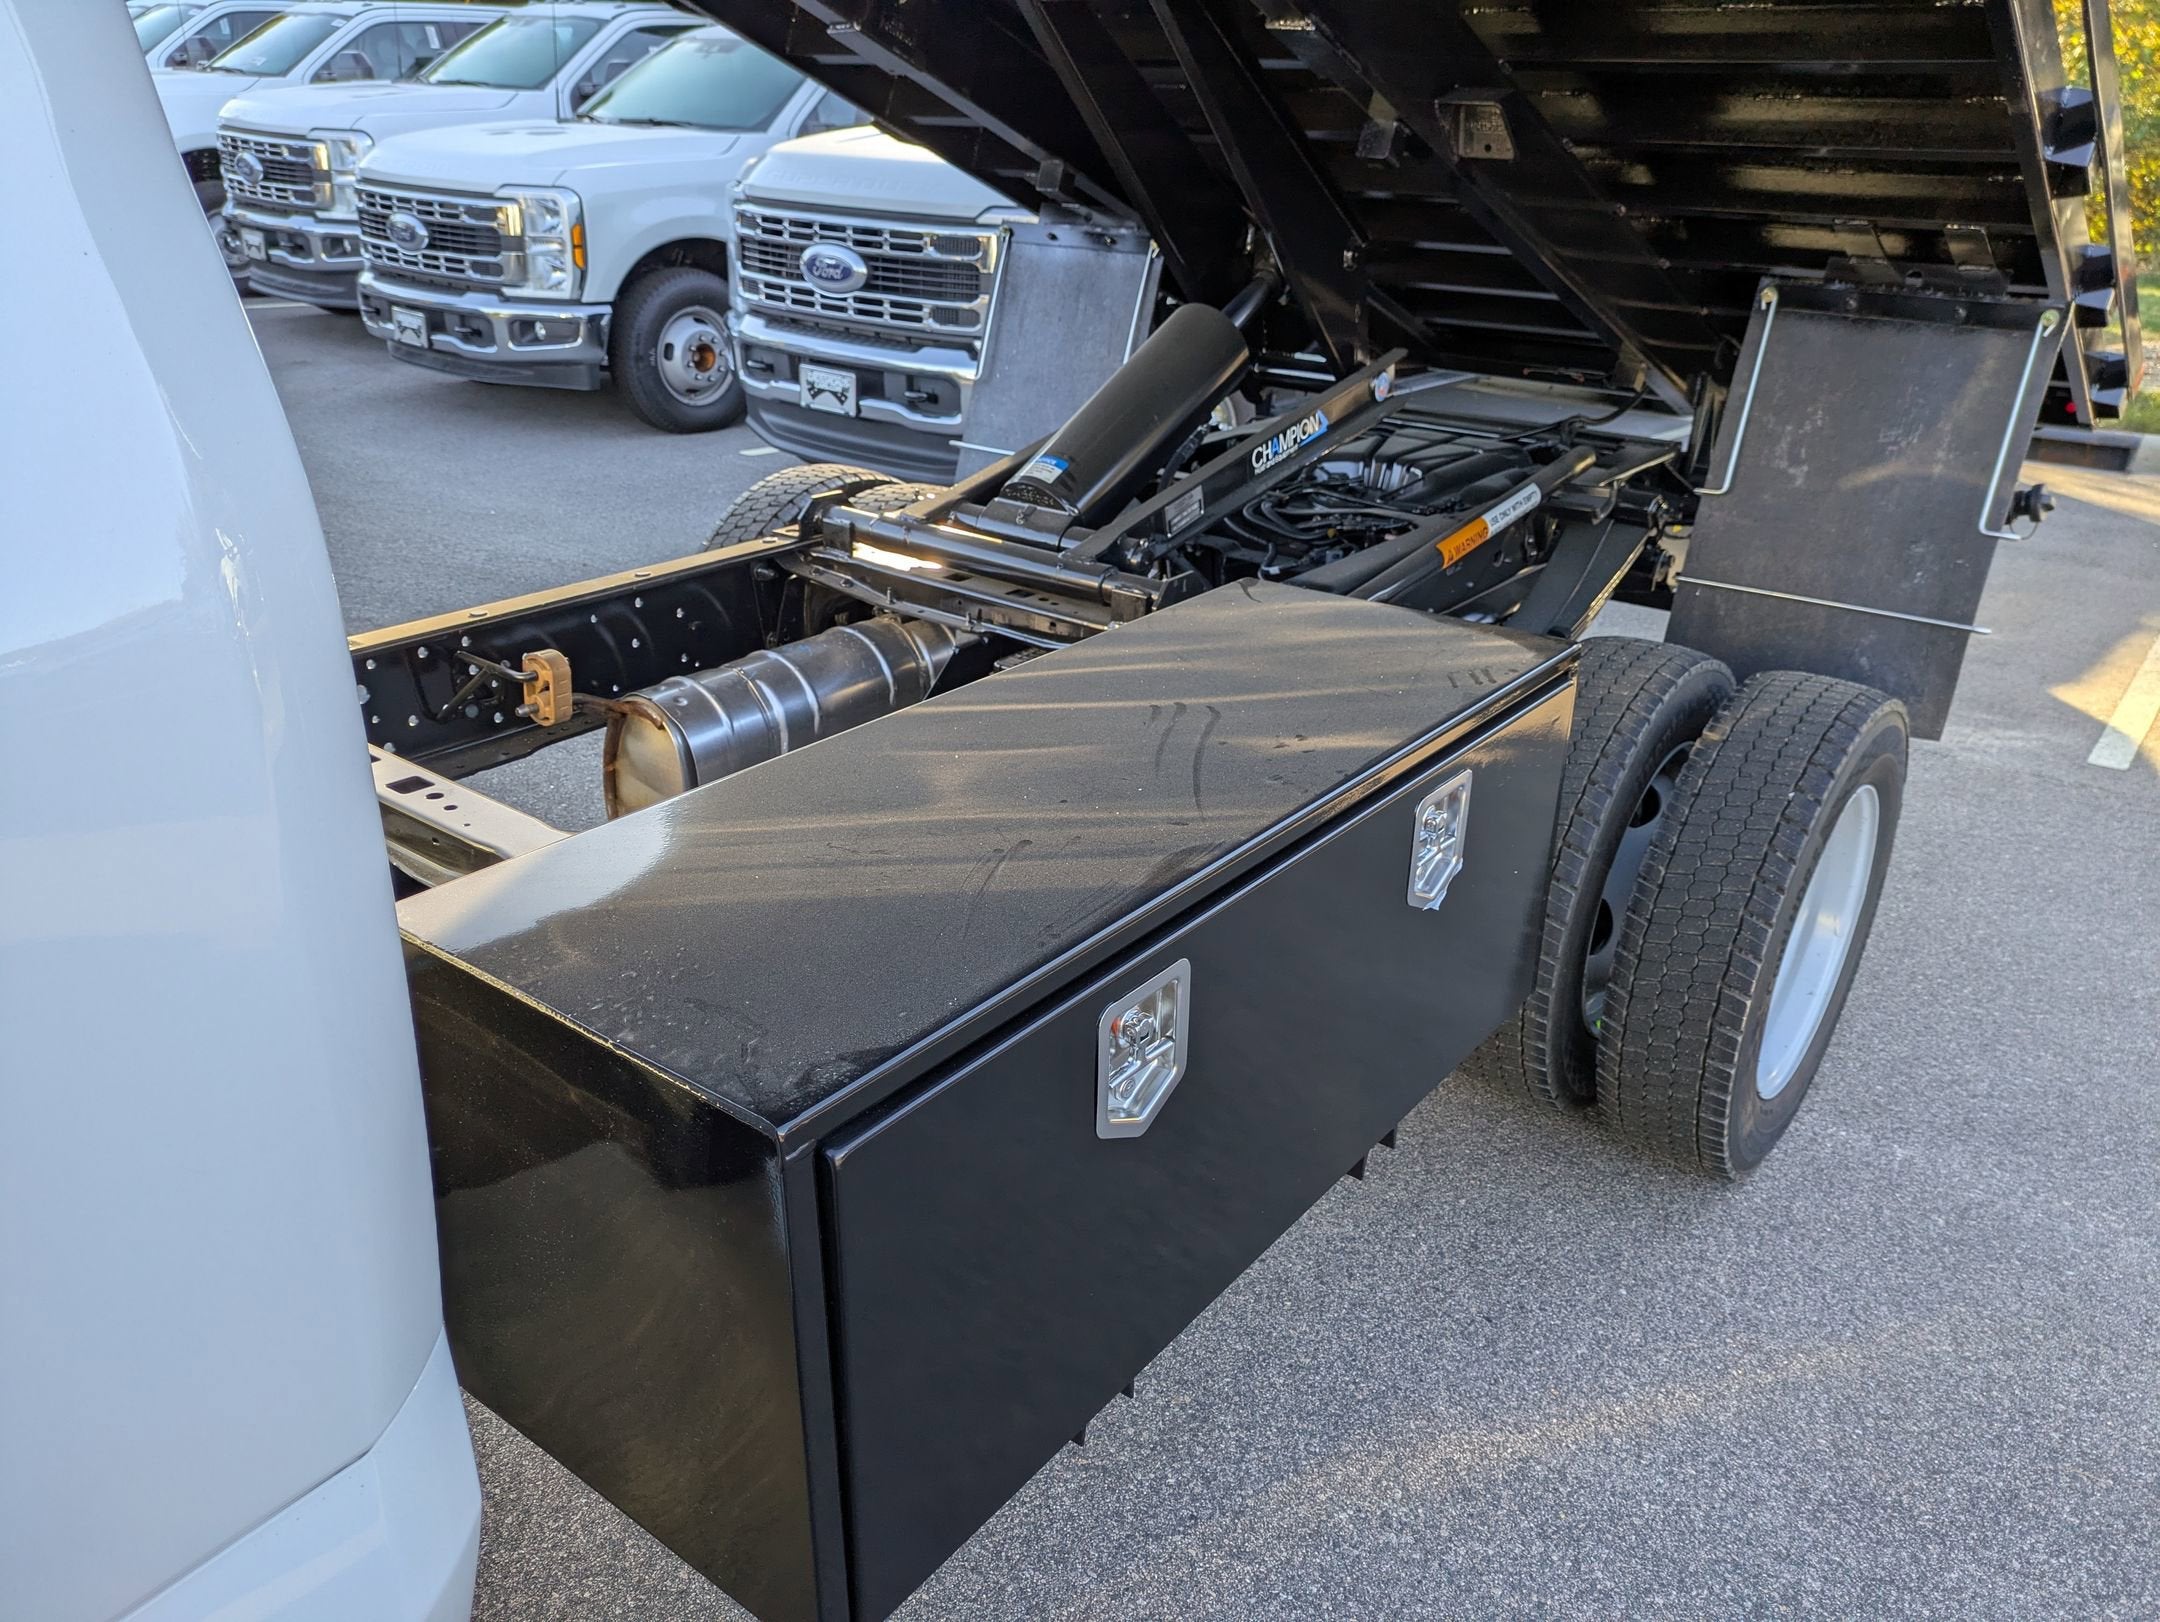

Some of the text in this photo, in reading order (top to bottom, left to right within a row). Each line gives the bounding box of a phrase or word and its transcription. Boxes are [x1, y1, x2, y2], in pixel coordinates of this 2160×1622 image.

[812, 256, 844, 281] Ford
[1251, 414, 1320, 468] CHAMPION
[1499, 508, 1512, 521] ONLY
[1454, 526, 1489, 557] WARNING
